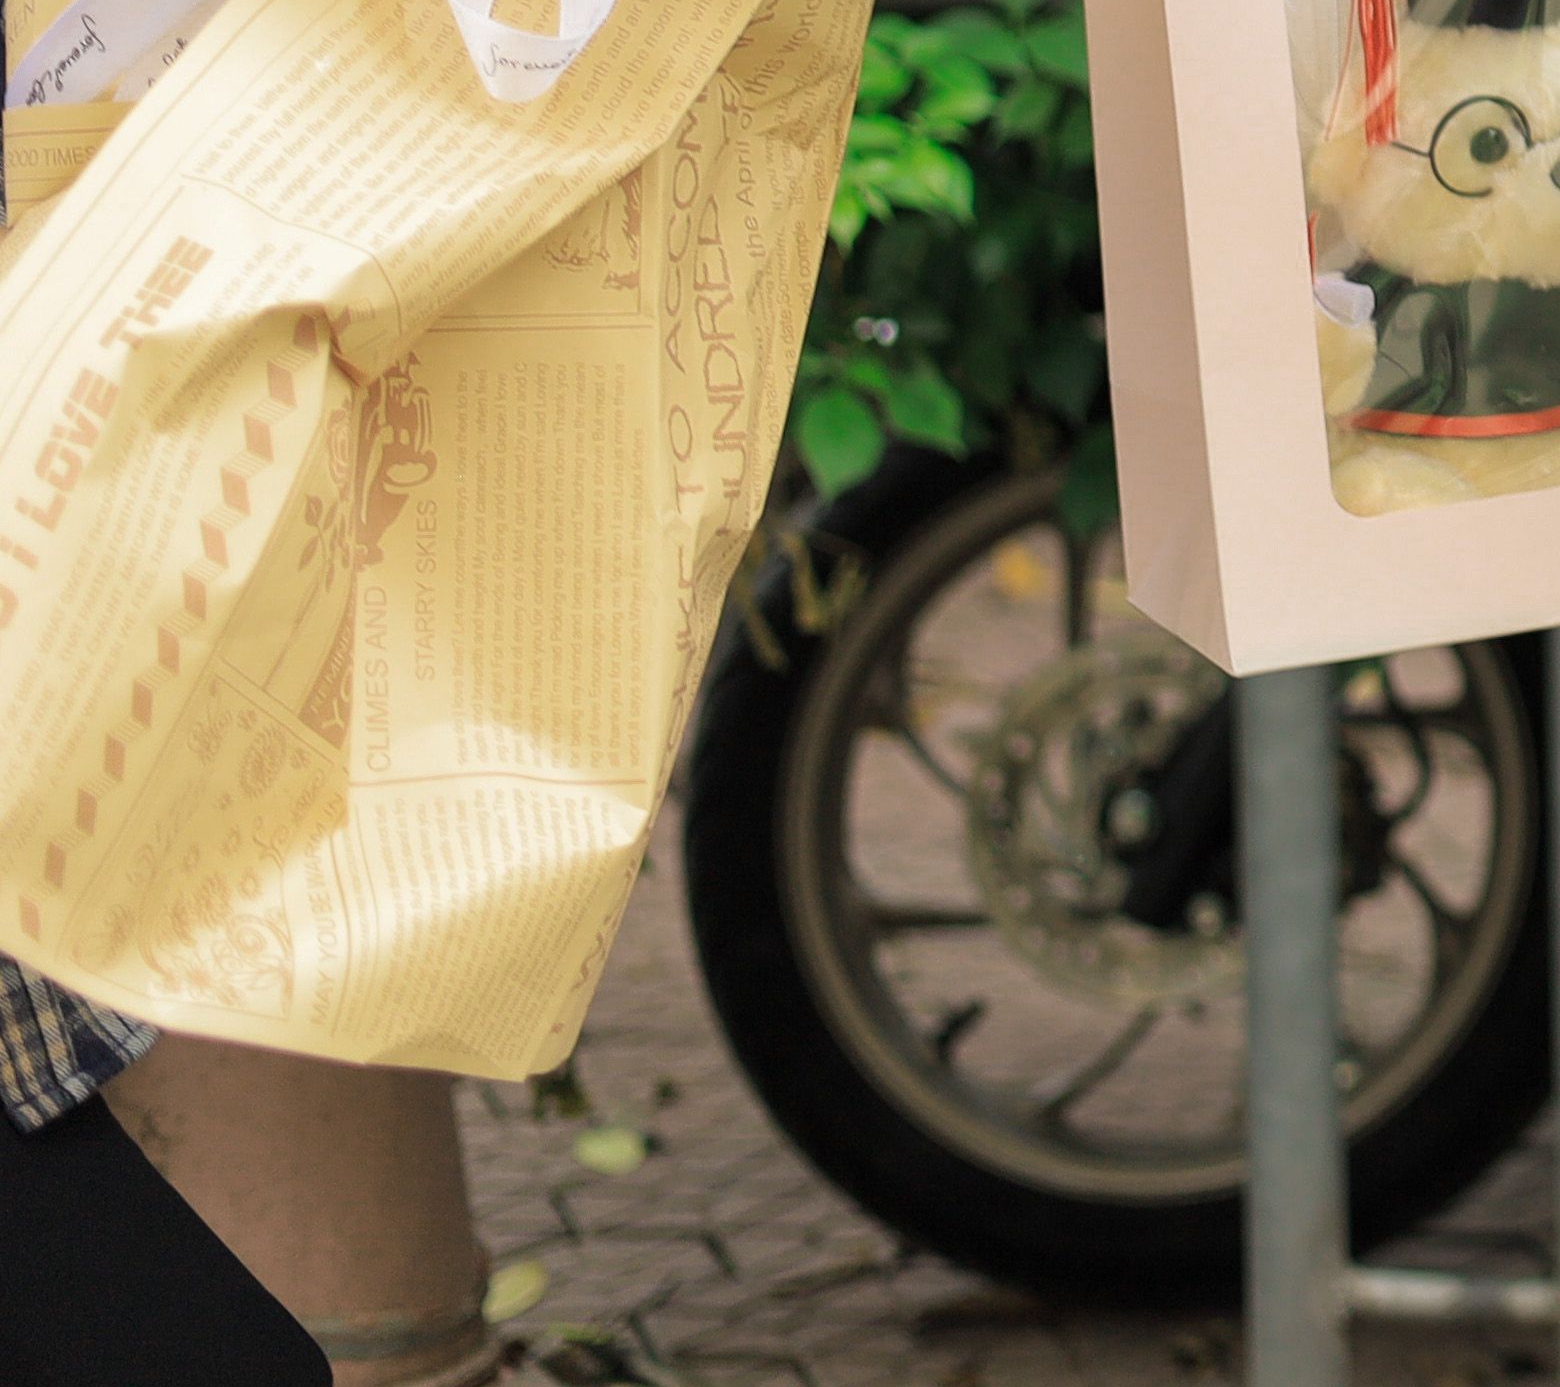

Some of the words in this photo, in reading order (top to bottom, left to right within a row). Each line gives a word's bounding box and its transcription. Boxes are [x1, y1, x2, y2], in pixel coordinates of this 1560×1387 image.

[736, 141, 759, 206] April
[16, 365, 120, 531] LOVE
[98, 234, 215, 354] THEE
[417, 500, 436, 574] SKIES
[364, 585, 387, 650] AND
[413, 580, 436, 680] STARRY
[365, 660, 391, 772] CLIMES
